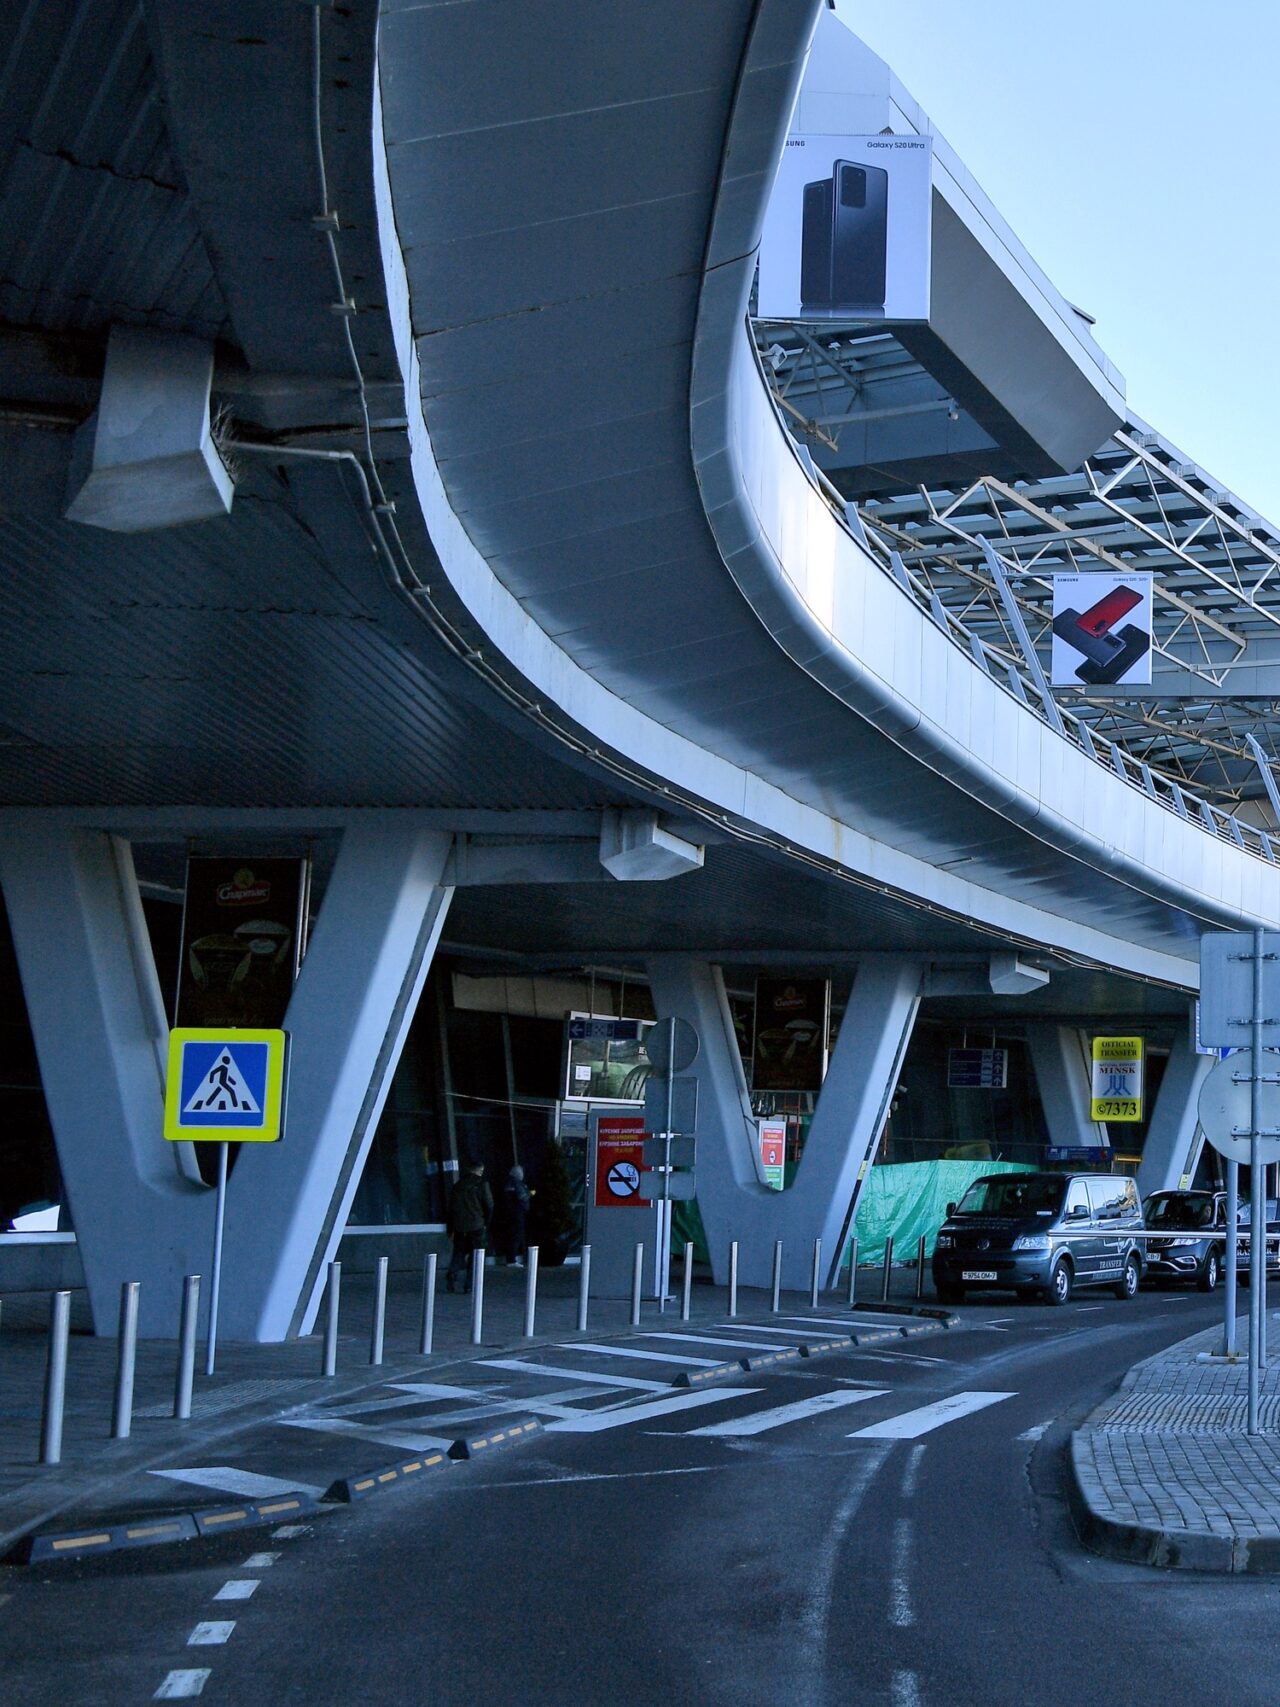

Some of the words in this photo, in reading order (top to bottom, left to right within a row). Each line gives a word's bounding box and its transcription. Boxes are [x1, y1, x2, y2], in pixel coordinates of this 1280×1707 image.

[866, 141, 894, 150] Galaxy
[1101, 1049, 1137, 1057] TRANSFER
[1105, 1102, 1137, 1116] 7373
